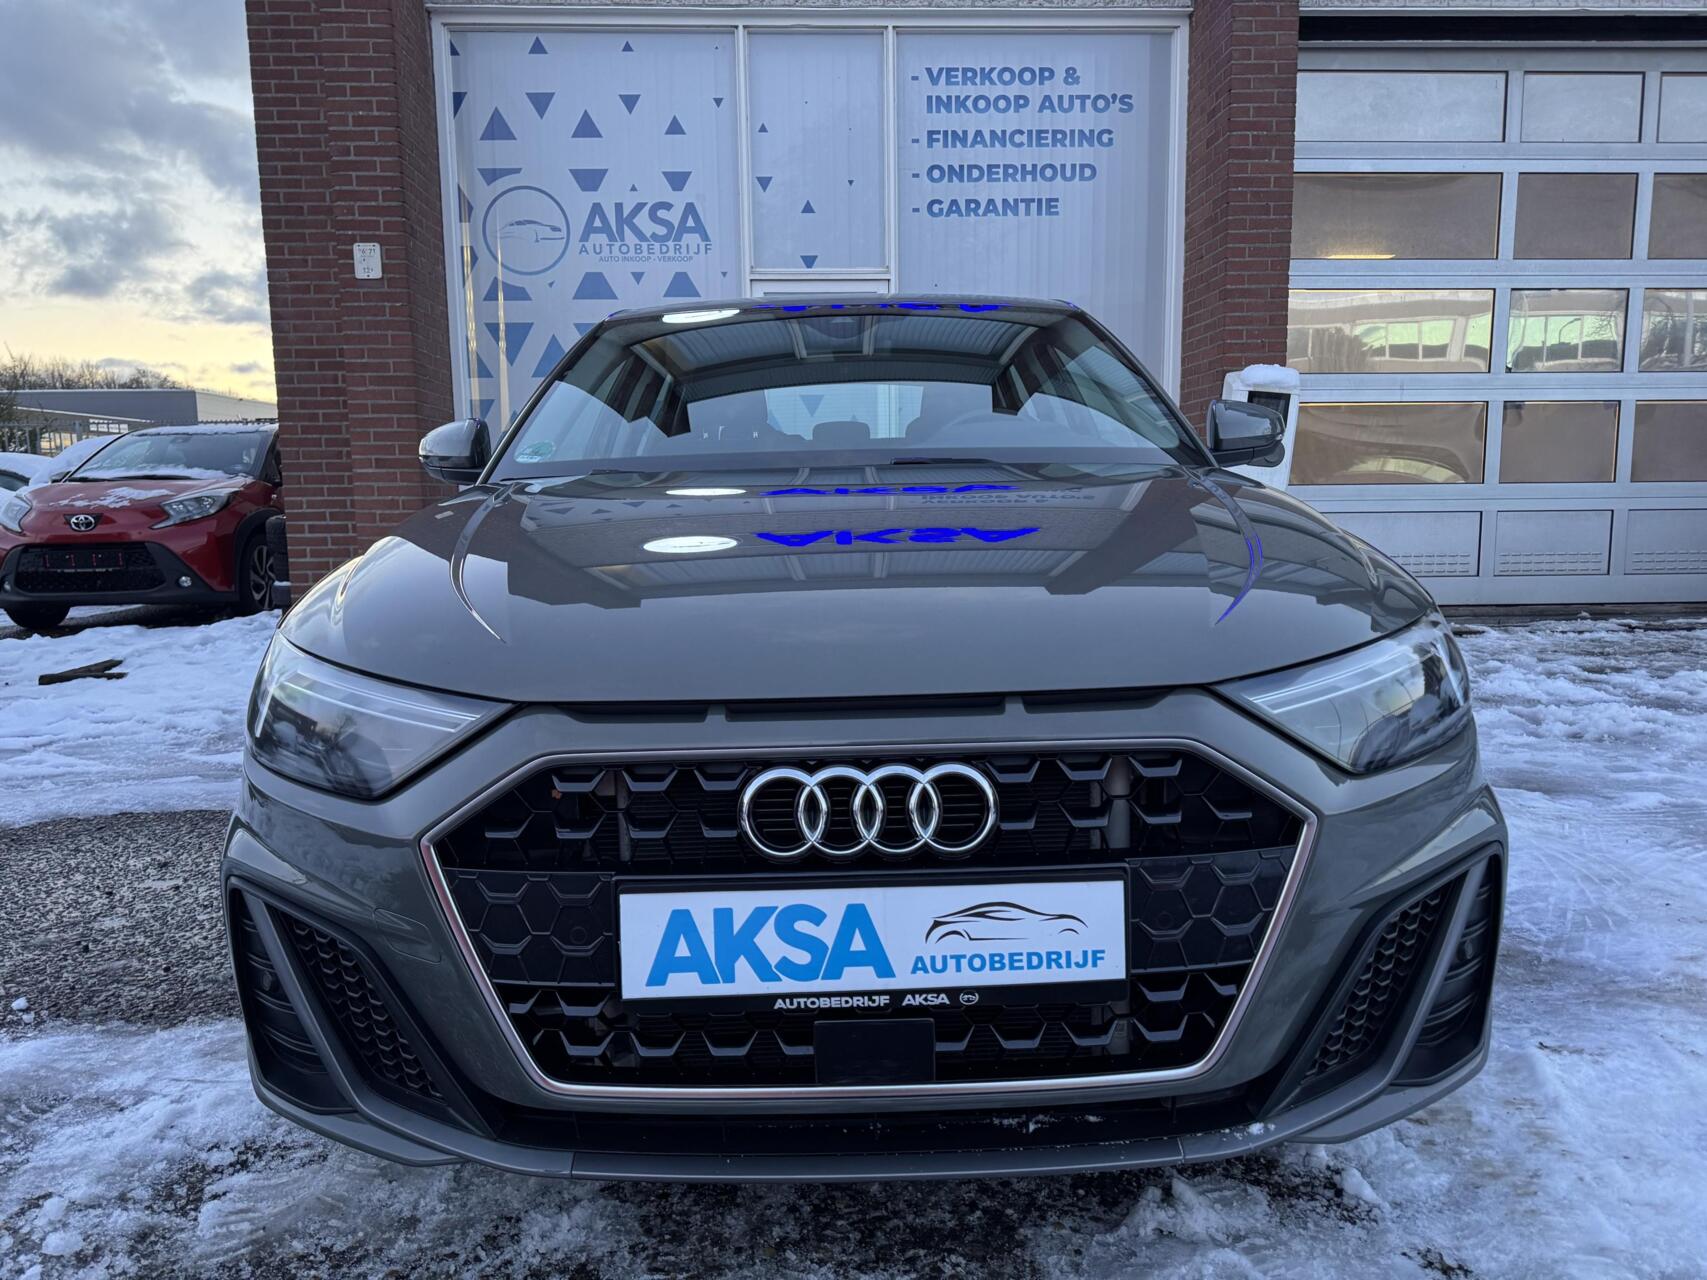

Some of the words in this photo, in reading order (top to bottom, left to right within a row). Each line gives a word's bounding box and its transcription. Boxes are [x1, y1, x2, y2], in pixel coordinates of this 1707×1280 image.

[925, 67, 1055, 86] VERKOOP
[1063, 66, 1081, 86] &
[926, 94, 1030, 114] INKOOP
[1037, 93, 1134, 113] AUTO'S
[926, 128, 1115, 149] FINANCIERING
[926, 163, 1097, 183] ONDERHOUD
[926, 197, 1060, 218] GARANTIE
[578, 201, 711, 243] AKSA
[578, 243, 713, 256] AUTOBEDRIJF
[657, 255, 694, 263] VERKOOP
[645, 902, 896, 987] AKSA
[910, 949, 1106, 975] AUTOBEDRIJF
[774, 995, 890, 1009] AUTOBEDRIJF
[902, 993, 950, 1006] AKSA
